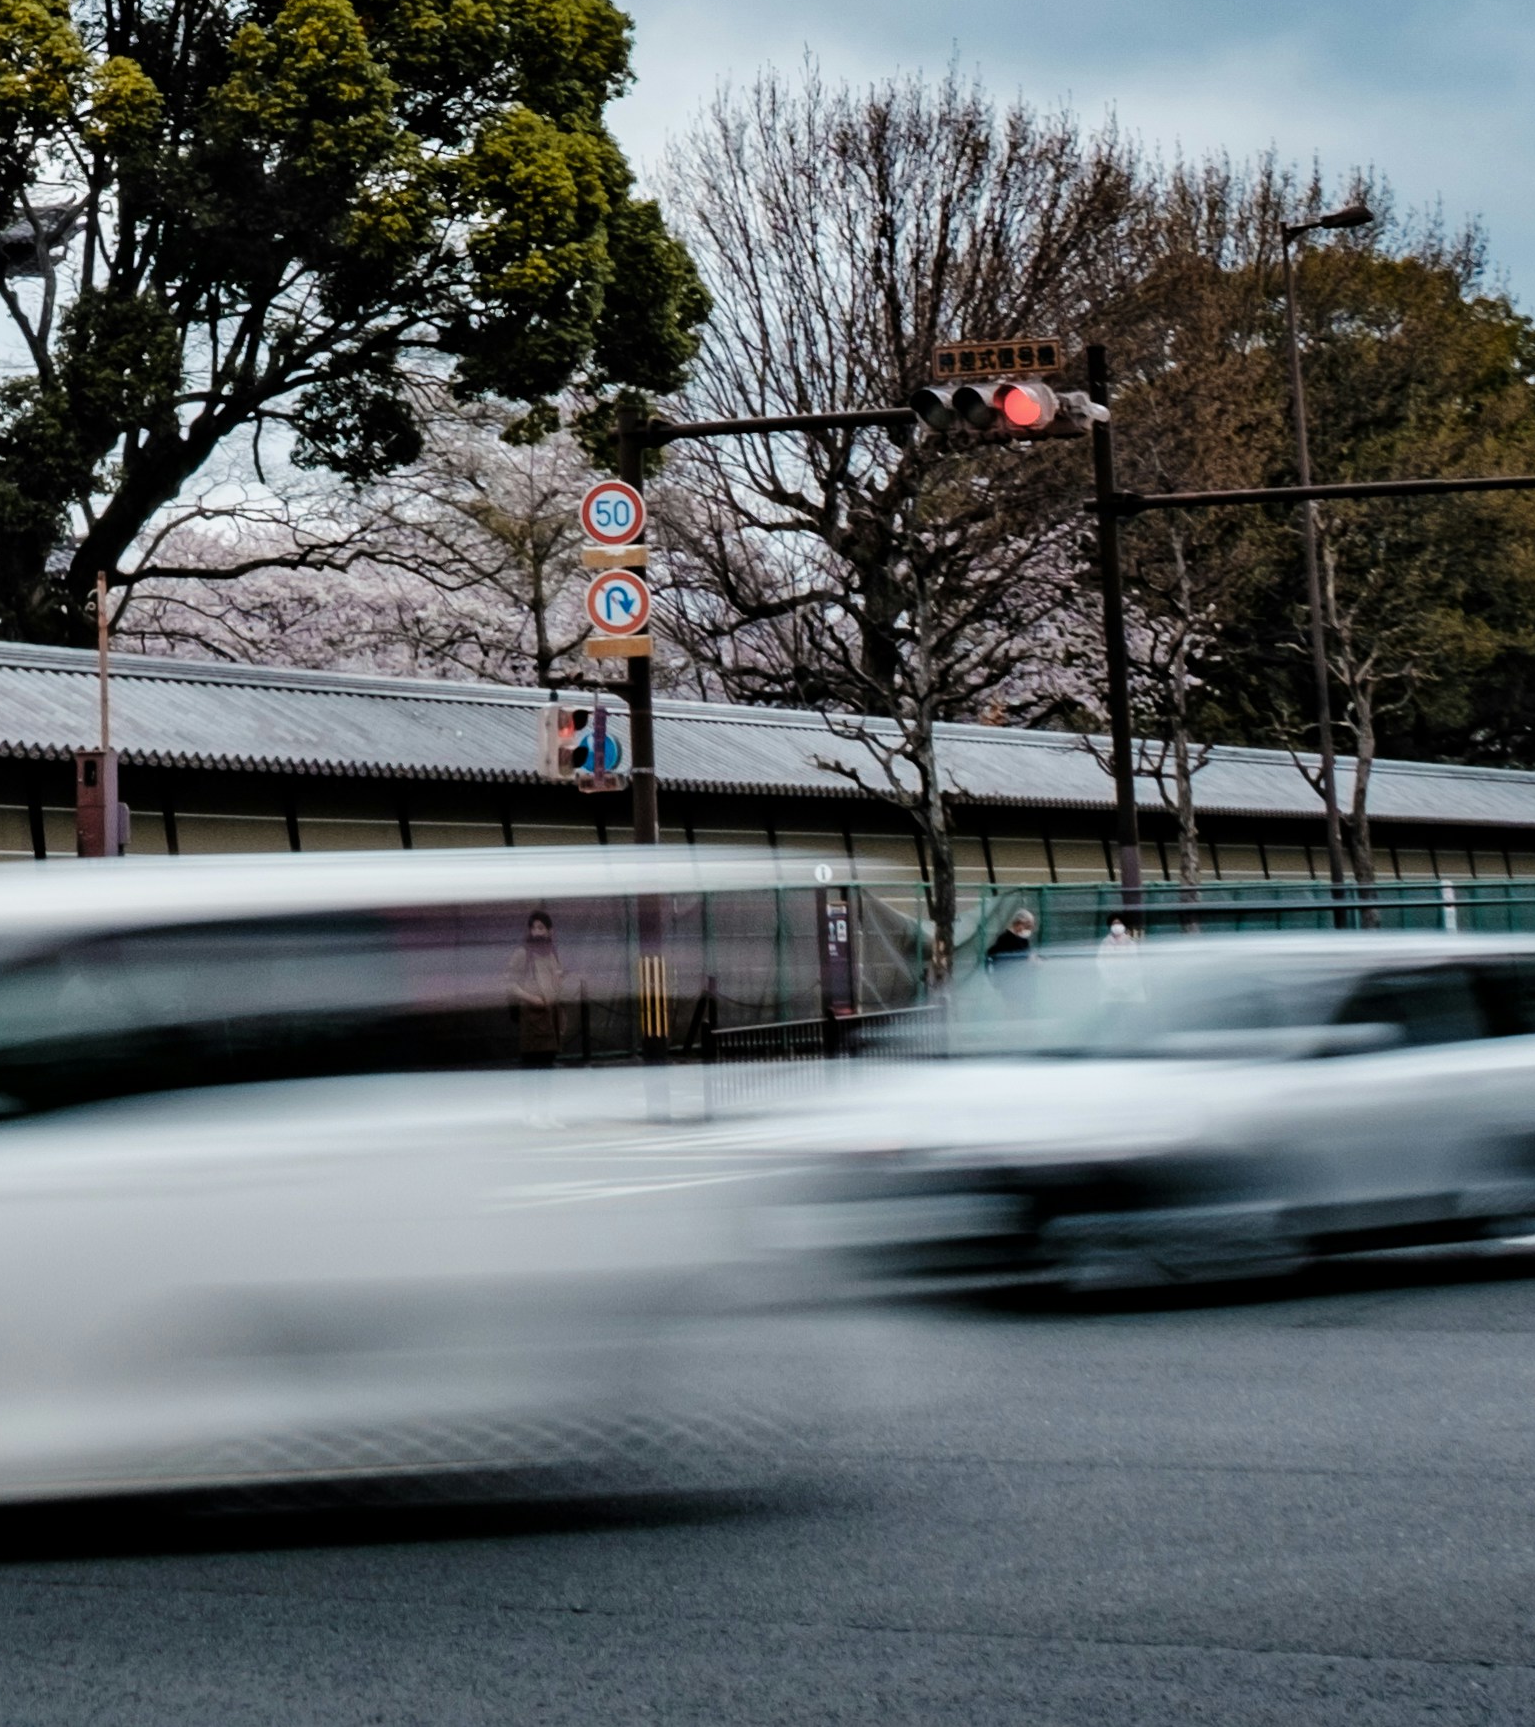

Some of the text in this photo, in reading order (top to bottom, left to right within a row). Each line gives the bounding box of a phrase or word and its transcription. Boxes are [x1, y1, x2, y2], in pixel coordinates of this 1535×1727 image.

[938, 345, 1056, 373] 時差式信号機
[595, 500, 630, 527] 50
